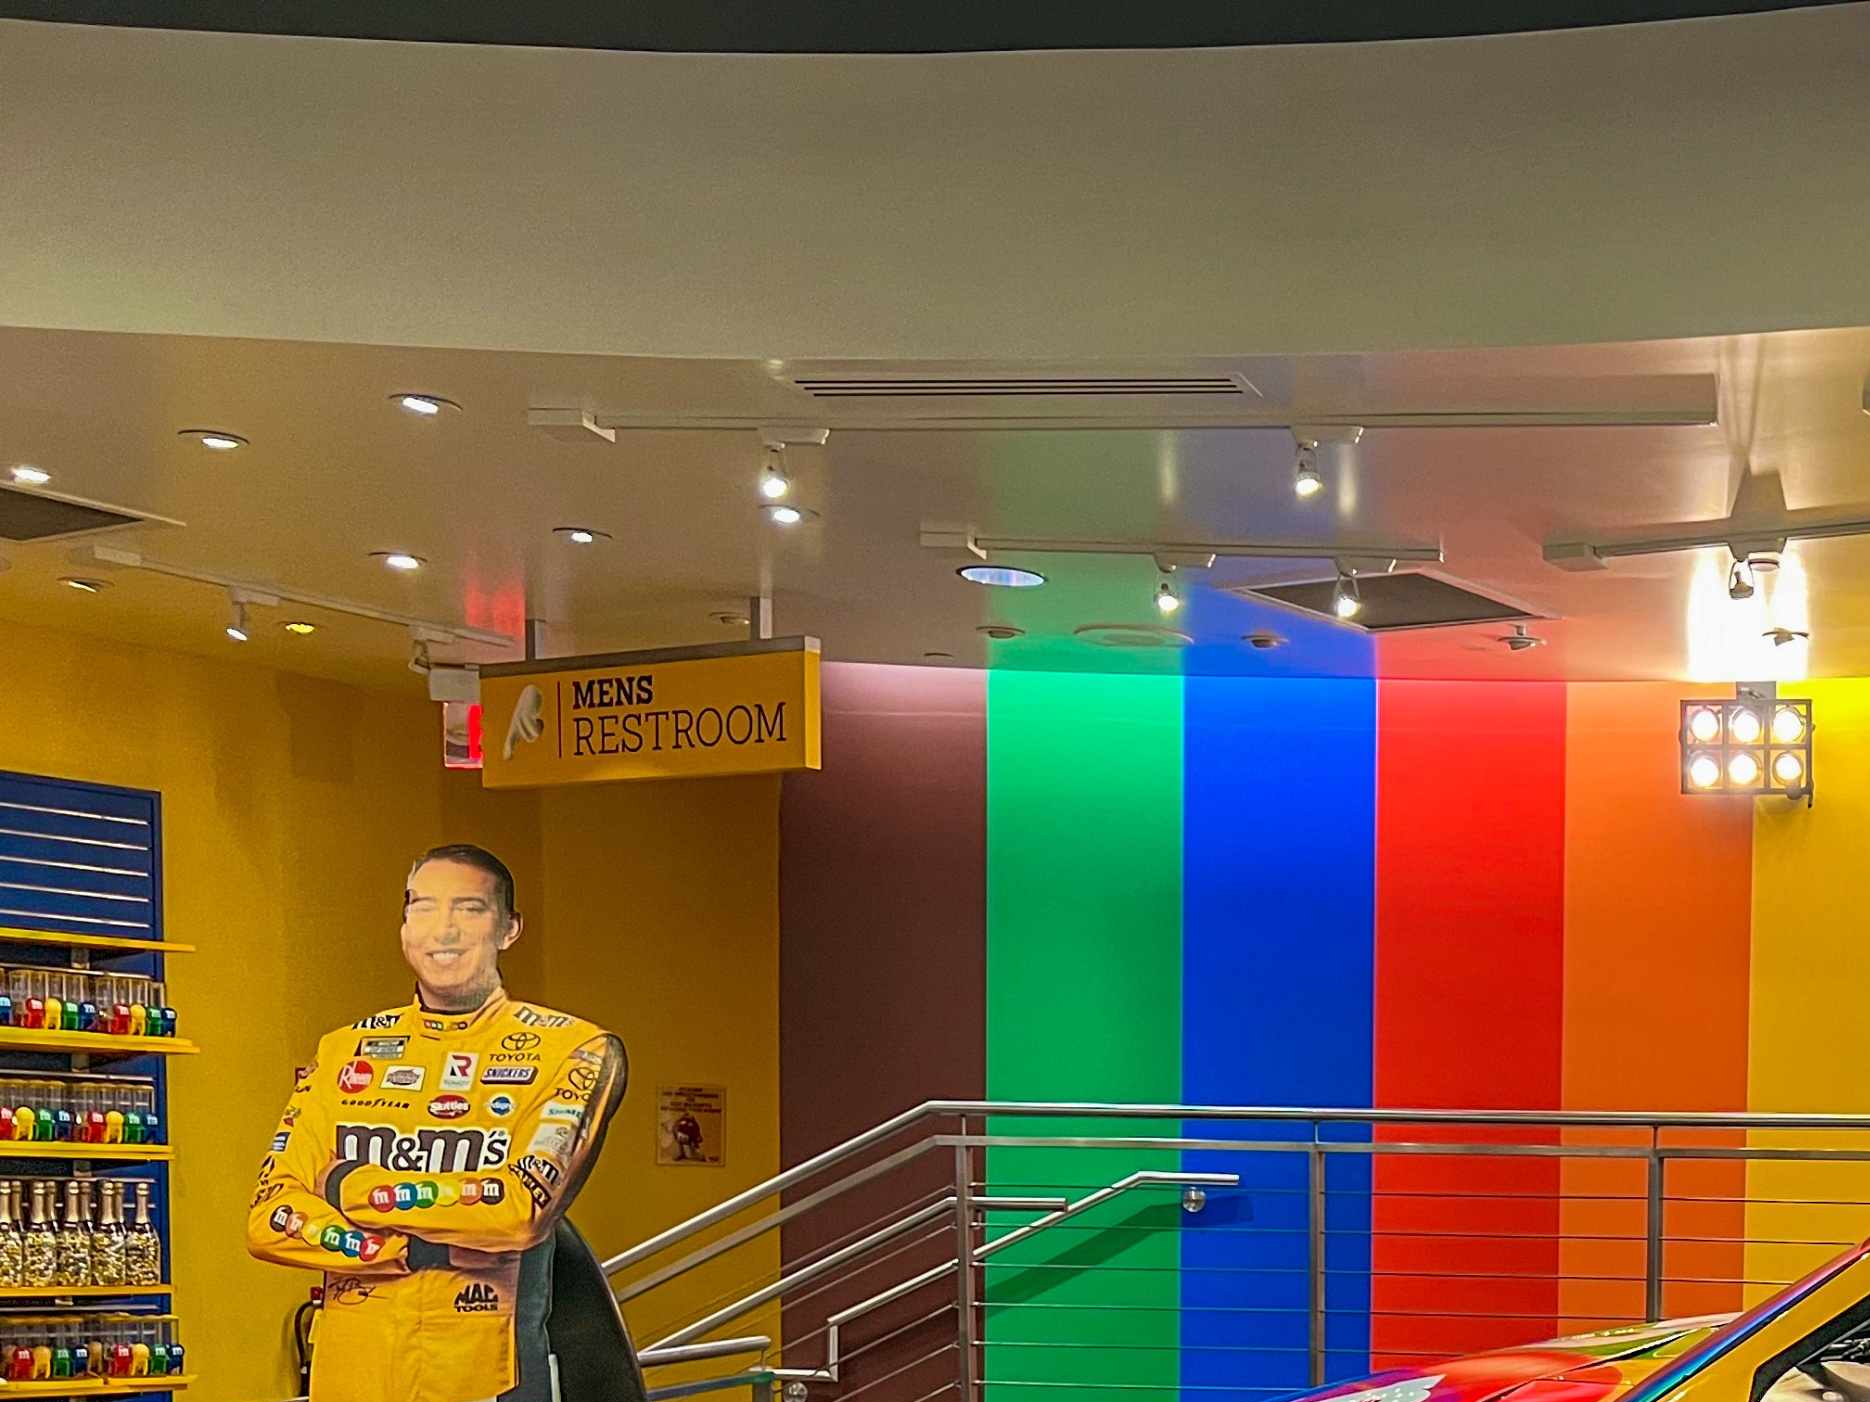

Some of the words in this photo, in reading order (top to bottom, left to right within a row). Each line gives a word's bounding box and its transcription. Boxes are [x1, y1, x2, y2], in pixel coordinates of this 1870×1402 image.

[571, 675, 654, 710] MENS
[573, 701, 787, 757] RESTROOM
[489, 1052, 541, 1063] TOYOTA
[483, 1067, 532, 1079] SNICKERS
[555, 1087, 592, 1103] TOYO
[341, 1097, 410, 1110] GOODYEAR
[335, 1124, 508, 1173] m&m's
[454, 1283, 499, 1305] MAC
[454, 1304, 498, 1313] TOOLS
